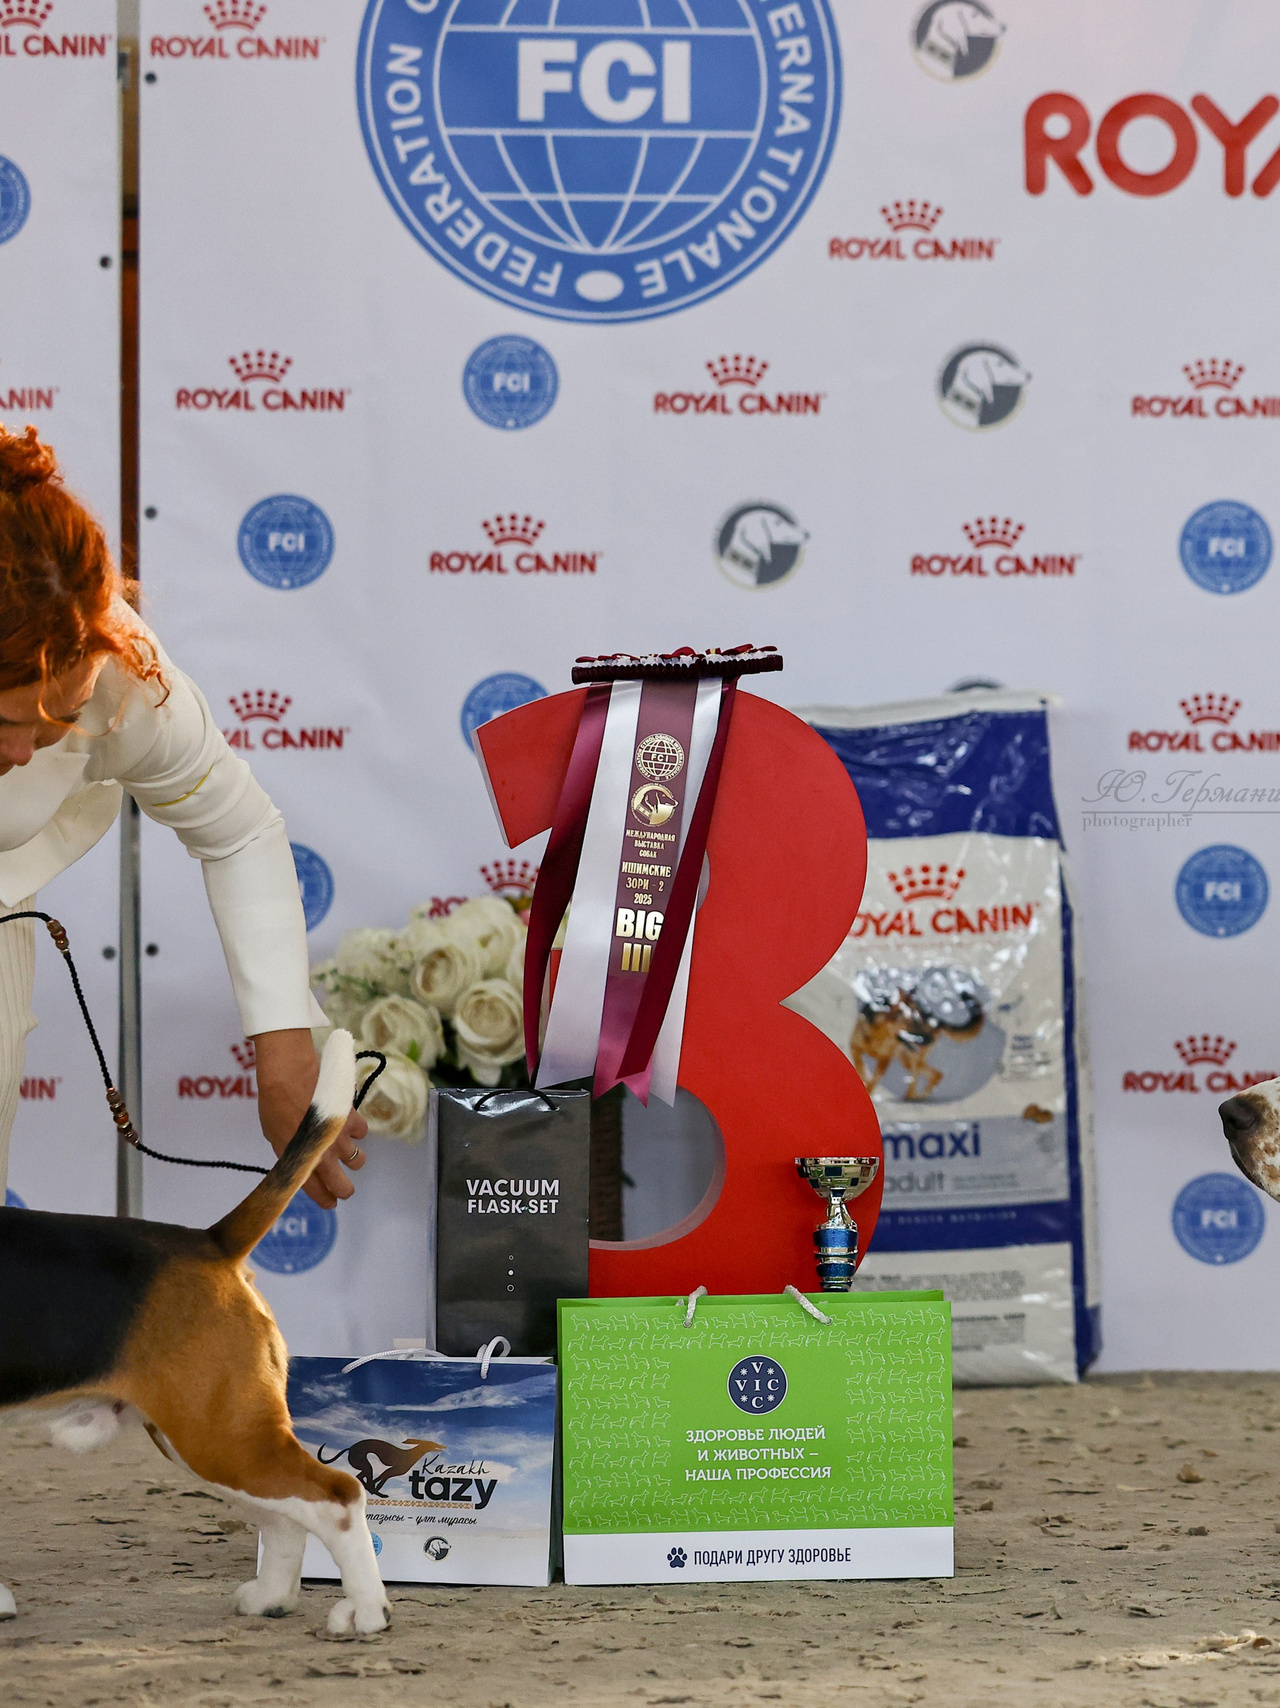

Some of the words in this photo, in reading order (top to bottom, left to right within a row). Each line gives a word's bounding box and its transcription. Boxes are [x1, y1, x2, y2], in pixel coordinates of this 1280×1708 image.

[23, 34, 105, 57] CANIN
[150, 36, 227, 58] ROYAL
[236, 37, 318, 59] CANIN
[516, 38, 692, 124] FCI
[386, 43, 564, 298] FEDERATION
[829, 238, 903, 259] ROYAL
[913, 239, 994, 260] CANIN
[492, 372, 530, 393] FCI
[175, 389, 254, 411] ROYAL
[262, 390, 345, 412] CANIN
[653, 392, 730, 413] ROYAL
[738, 395, 820, 414] CANIN
[1131, 396, 1207, 417] ROYAL
[268, 532, 306, 552] FCI
[1208, 537, 1246, 558] FCI
[429, 552, 506, 573] ROYAL
[515, 554, 597, 574] CANIN
[911, 555, 987, 575] ROYAL
[995, 557, 1076, 576] CANIN
[262, 728, 344, 749] CANIN
[1128, 731, 1204, 752] ROYAL
[650, 753, 670, 763] FCI
[625, 829, 676, 841] МЕЖДУНАРОДНАЯ
[634, 840, 665, 850] ВЫСТАВКА
[639, 849, 658, 858] СОБАК
[621, 861, 672, 878] ИШИМСКИЕ
[626, 877, 650, 891] ЗОРИ
[658, 880, 664, 892] 2
[1203, 880, 1242, 902] FCI
[633, 892, 653, 905] 2025
[615, 907, 665, 941] BIG
[850, 911, 923, 937] OYAL
[621, 942, 652, 973] III
[177, 1076, 257, 1098] ROYAL
[1123, 1072, 1199, 1093] ROYAL
[882, 1122, 980, 1160] maxi
[466, 1179, 560, 1196] VACUUM
[1201, 1208, 1239, 1230] FCI
[686, 1428, 764, 1443] ЗДОРОВЬЕ
[768, 1425, 826, 1441] ЛЮДЕЙ
[422, 1454, 491, 1475] Kazakh
[697, 1449, 709, 1461] И
[714, 1448, 805, 1461] ЖИВОТНЫХ
[685, 1468, 732, 1481] НАША
[736, 1466, 832, 1480] ПРОФЕССИЯ
[409, 1470, 498, 1510] tazy
[694, 1550, 743, 1566] ПОДАРИ
[746, 1549, 785, 1566] ДРУГУ
[789, 1547, 852, 1564] ЗДОРОВЬЕ
